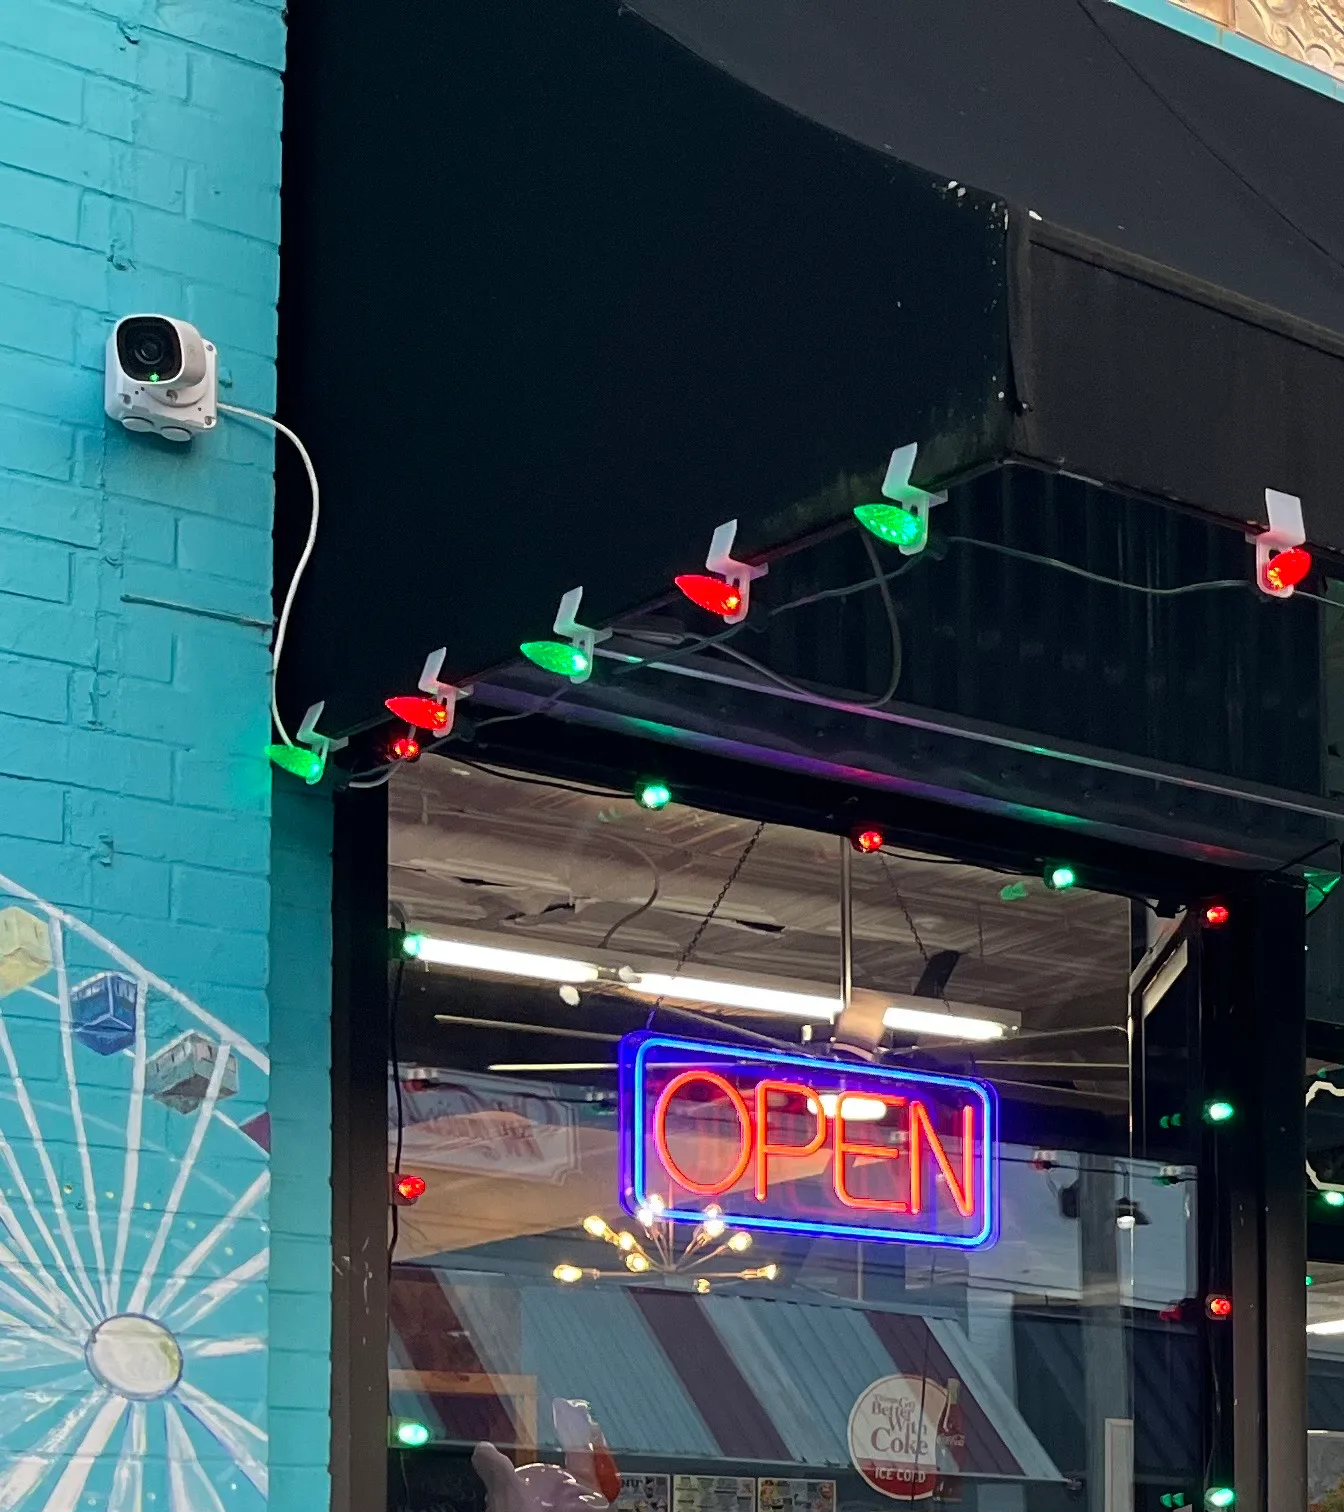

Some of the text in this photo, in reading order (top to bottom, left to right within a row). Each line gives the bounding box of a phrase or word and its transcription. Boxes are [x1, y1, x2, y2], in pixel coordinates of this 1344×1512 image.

[654, 1070, 974, 1217] OPEN
[872, 1401, 911, 1421] Better
[870, 1427, 929, 1456] Coke
[875, 1467, 926, 1482] ICE COLD
